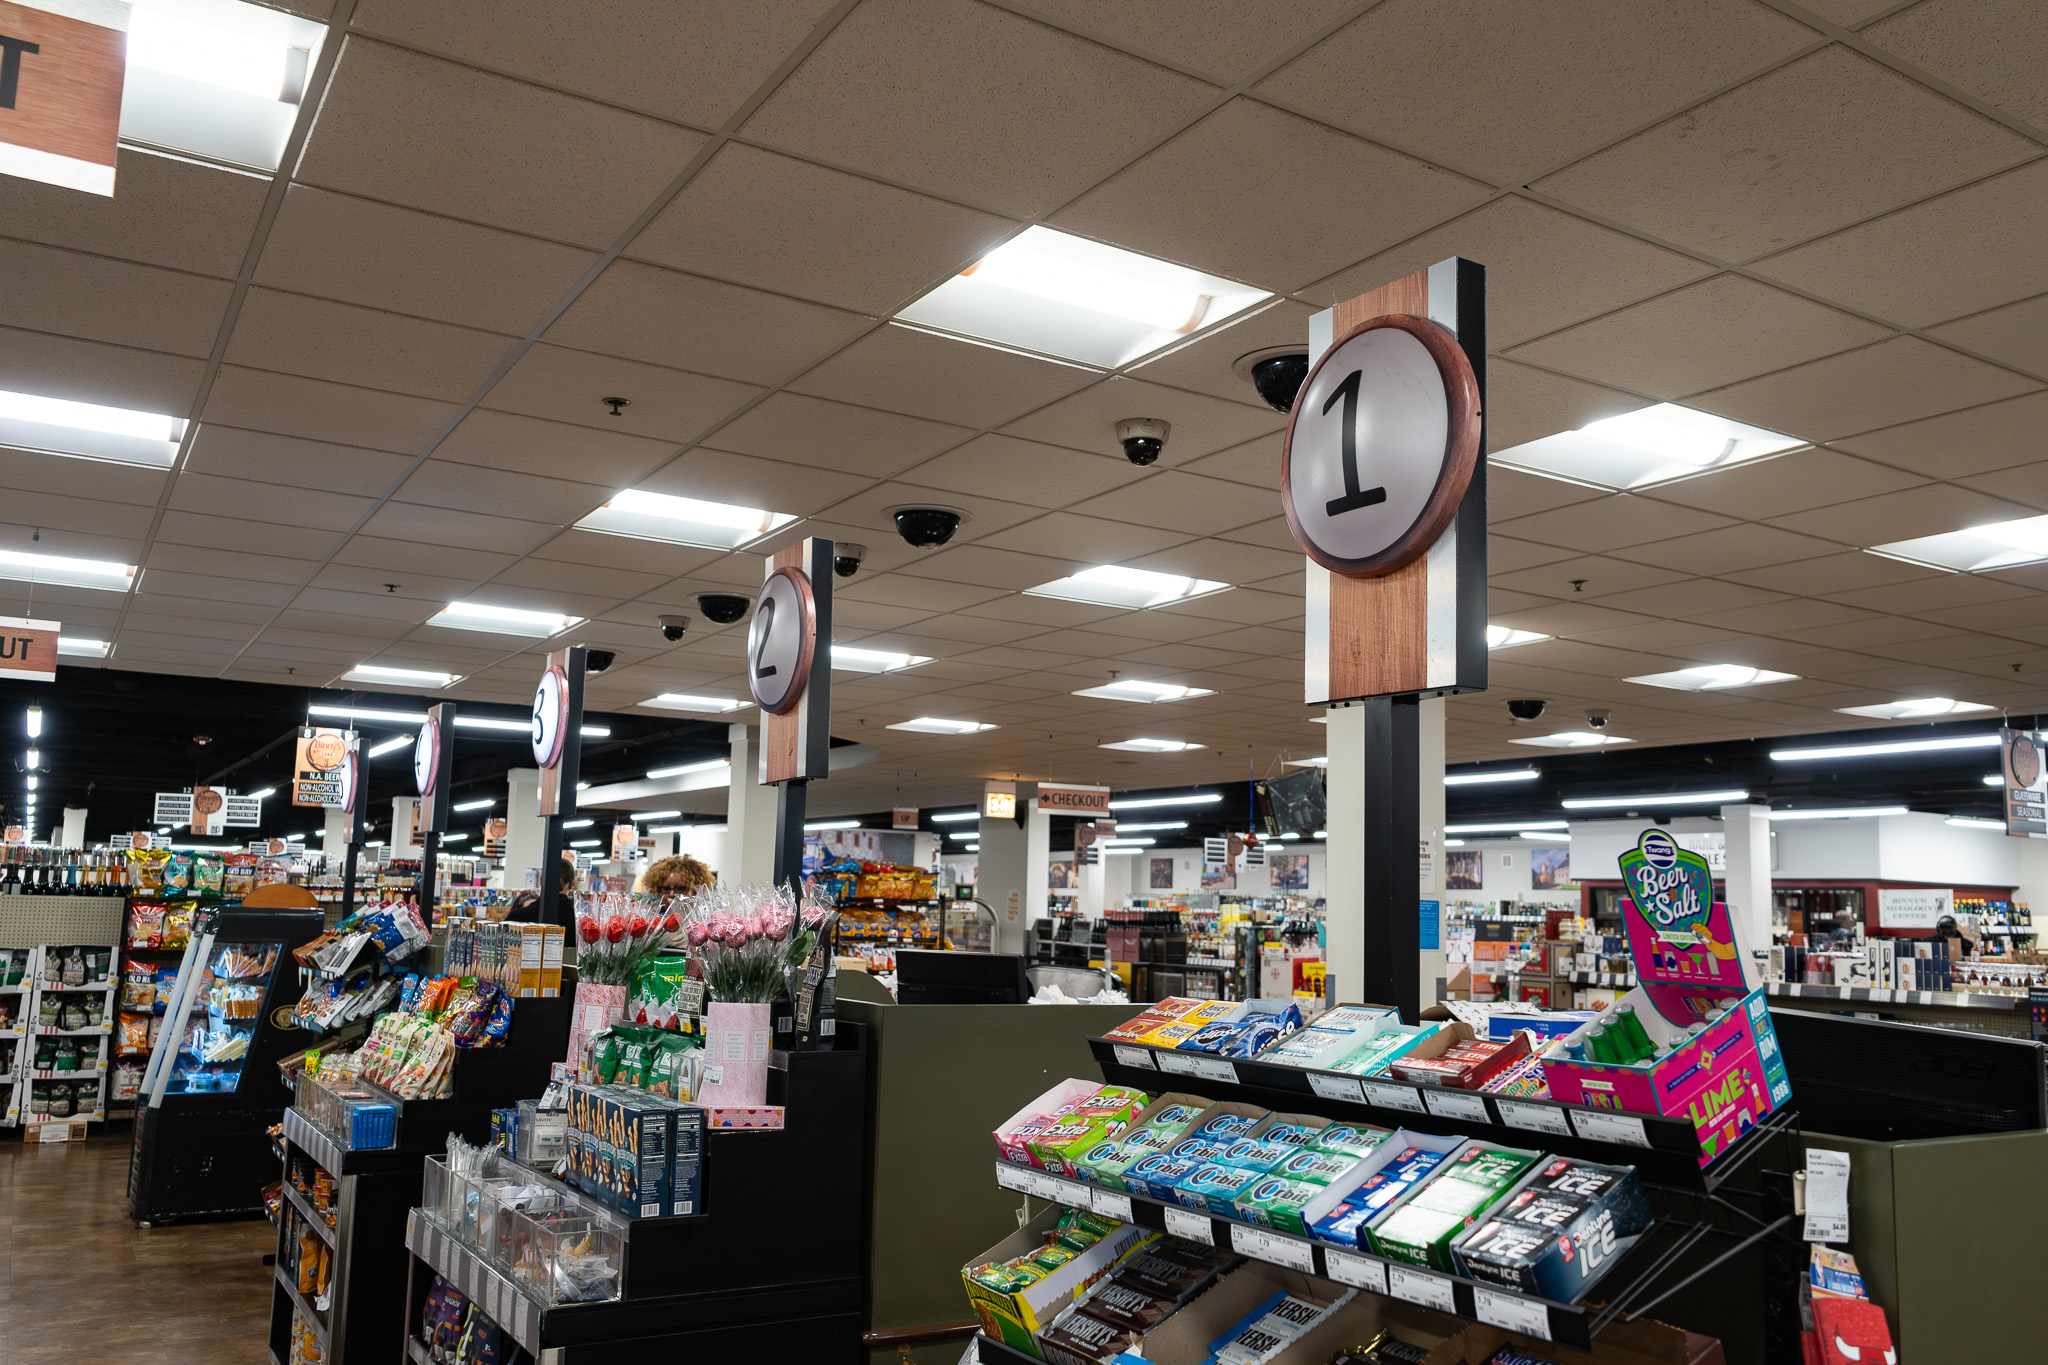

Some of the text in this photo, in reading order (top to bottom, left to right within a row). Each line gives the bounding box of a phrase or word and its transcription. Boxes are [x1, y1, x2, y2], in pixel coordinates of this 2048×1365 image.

[0, 34, 40, 110] T
[1322, 369, 1387, 517] 1
[0, 636, 33, 661] UT
[756, 596, 777, 679] 2
[533, 687, 545, 745] 3
[309, 772, 323, 780] N.A.
[1052, 793, 1106, 808] CHECKOUT
[2014, 790, 2042, 802] GLASSWARE
[900, 814, 910, 822] UP
[2016, 806, 2043, 818] SEASONAL
[1646, 846, 1672, 855] Twang
[1637, 865, 1688, 898] Beer
[1655, 883, 1701, 925] Salt
[1749, 995, 1766, 1021] ADD
[1188, 1026, 1242, 1042] eclipse
[1758, 1033, 1778, 1061] RIM
[1426, 1094, 1439, 1102] 1.79
[1688, 1067, 1746, 1130] LIME
[1123, 1128, 1168, 1149] Orbit
[1319, 1126, 1380, 1149] Orbit
[1009, 1151, 1029, 1163] Extra
[1085, 1141, 1133, 1164] Orbit
[1224, 1139, 1279, 1161] Orbit
[1480, 1153, 1521, 1169] Dentyne
[1135, 1155, 1189, 1177] Orbit
[1286, 1152, 1345, 1174] Orbit
[1462, 1161, 1513, 1180] ICE
[1190, 1164, 1247, 1187] Orbit
[1548, 1174, 1606, 1195] ICE
[1566, 1167, 1612, 1183] Dentyne
[1180, 1194, 1209, 1211] Orbit
[1252, 1178, 1313, 1205] Orbit
[1515, 1205, 1574, 1227] ICE
[1532, 1197, 1579, 1214] Dentyne
[1240, 1208, 1271, 1228] Orbit
[1572, 1208, 1612, 1249] Dentyne
[1233, 1231, 1243, 1239] 1.79
[1259, 1238, 1270, 1247] 1.79
[1380, 1239, 1428, 1261] Dentyne ICE
[1479, 1236, 1538, 1260] ICE
[1578, 1220, 1617, 1279] ICE
[1328, 1255, 1340, 1265] 1.79
[1467, 1258, 1521, 1283] Dentyne ICE
[1392, 1273, 1404, 1283] 1.79
[1097, 1281, 1152, 1313] HERSHEY'S
[1477, 1295, 1492, 1306] 1.79
[1115, 1307, 1133, 1318] chocolate
[1065, 1312, 1119, 1346] HERSHEY'S
[1069, 1336, 1098, 1351] milk chocolate
